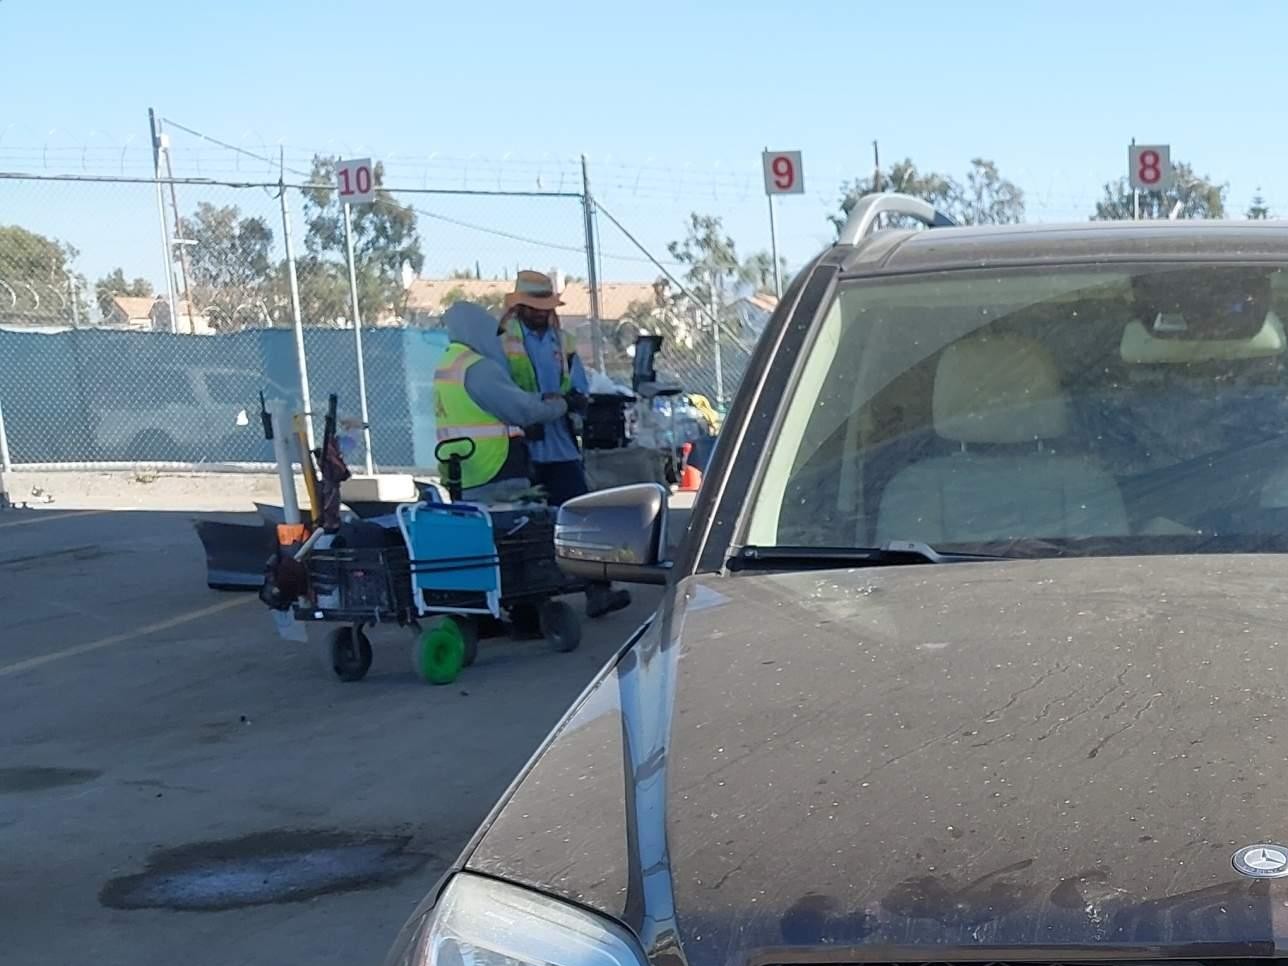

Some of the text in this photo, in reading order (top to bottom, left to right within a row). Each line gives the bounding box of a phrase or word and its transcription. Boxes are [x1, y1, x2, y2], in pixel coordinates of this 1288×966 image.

[339, 166, 371, 196] 10
[773, 156, 793, 190] 9
[1139, 150, 1160, 184] 8
